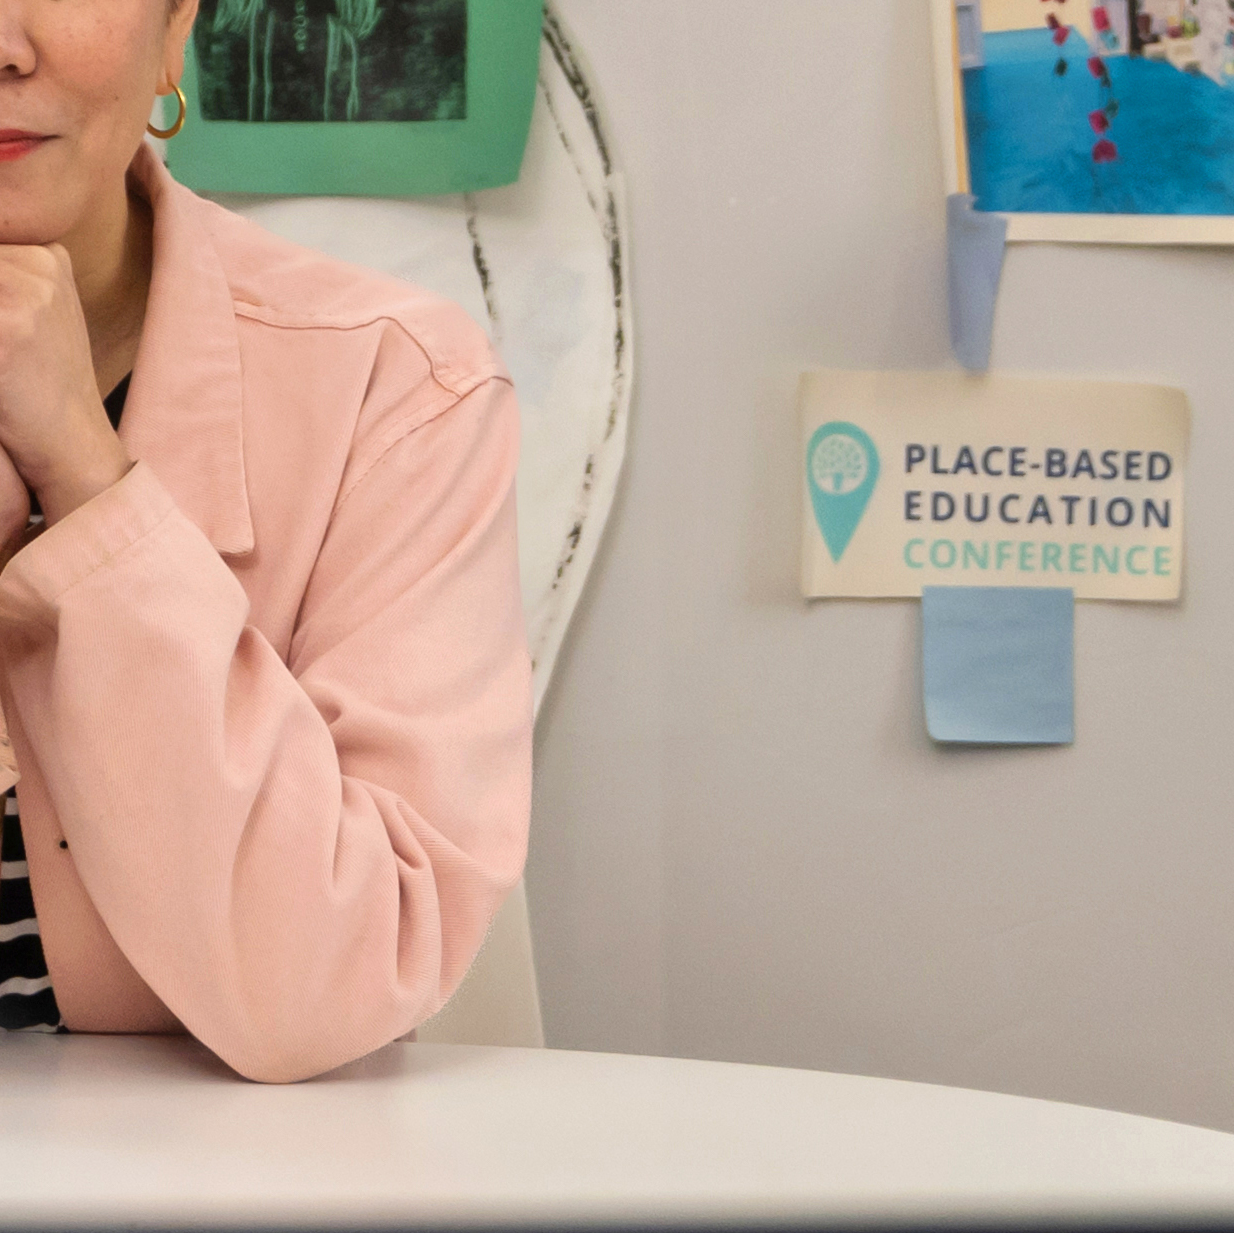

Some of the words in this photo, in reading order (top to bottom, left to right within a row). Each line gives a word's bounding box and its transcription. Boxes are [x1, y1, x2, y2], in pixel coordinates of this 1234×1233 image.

[904, 443, 1174, 482] PLACE-BASED
[904, 490, 1173, 529] EDUCATION
[903, 538, 1173, 577] CONFERENCE
